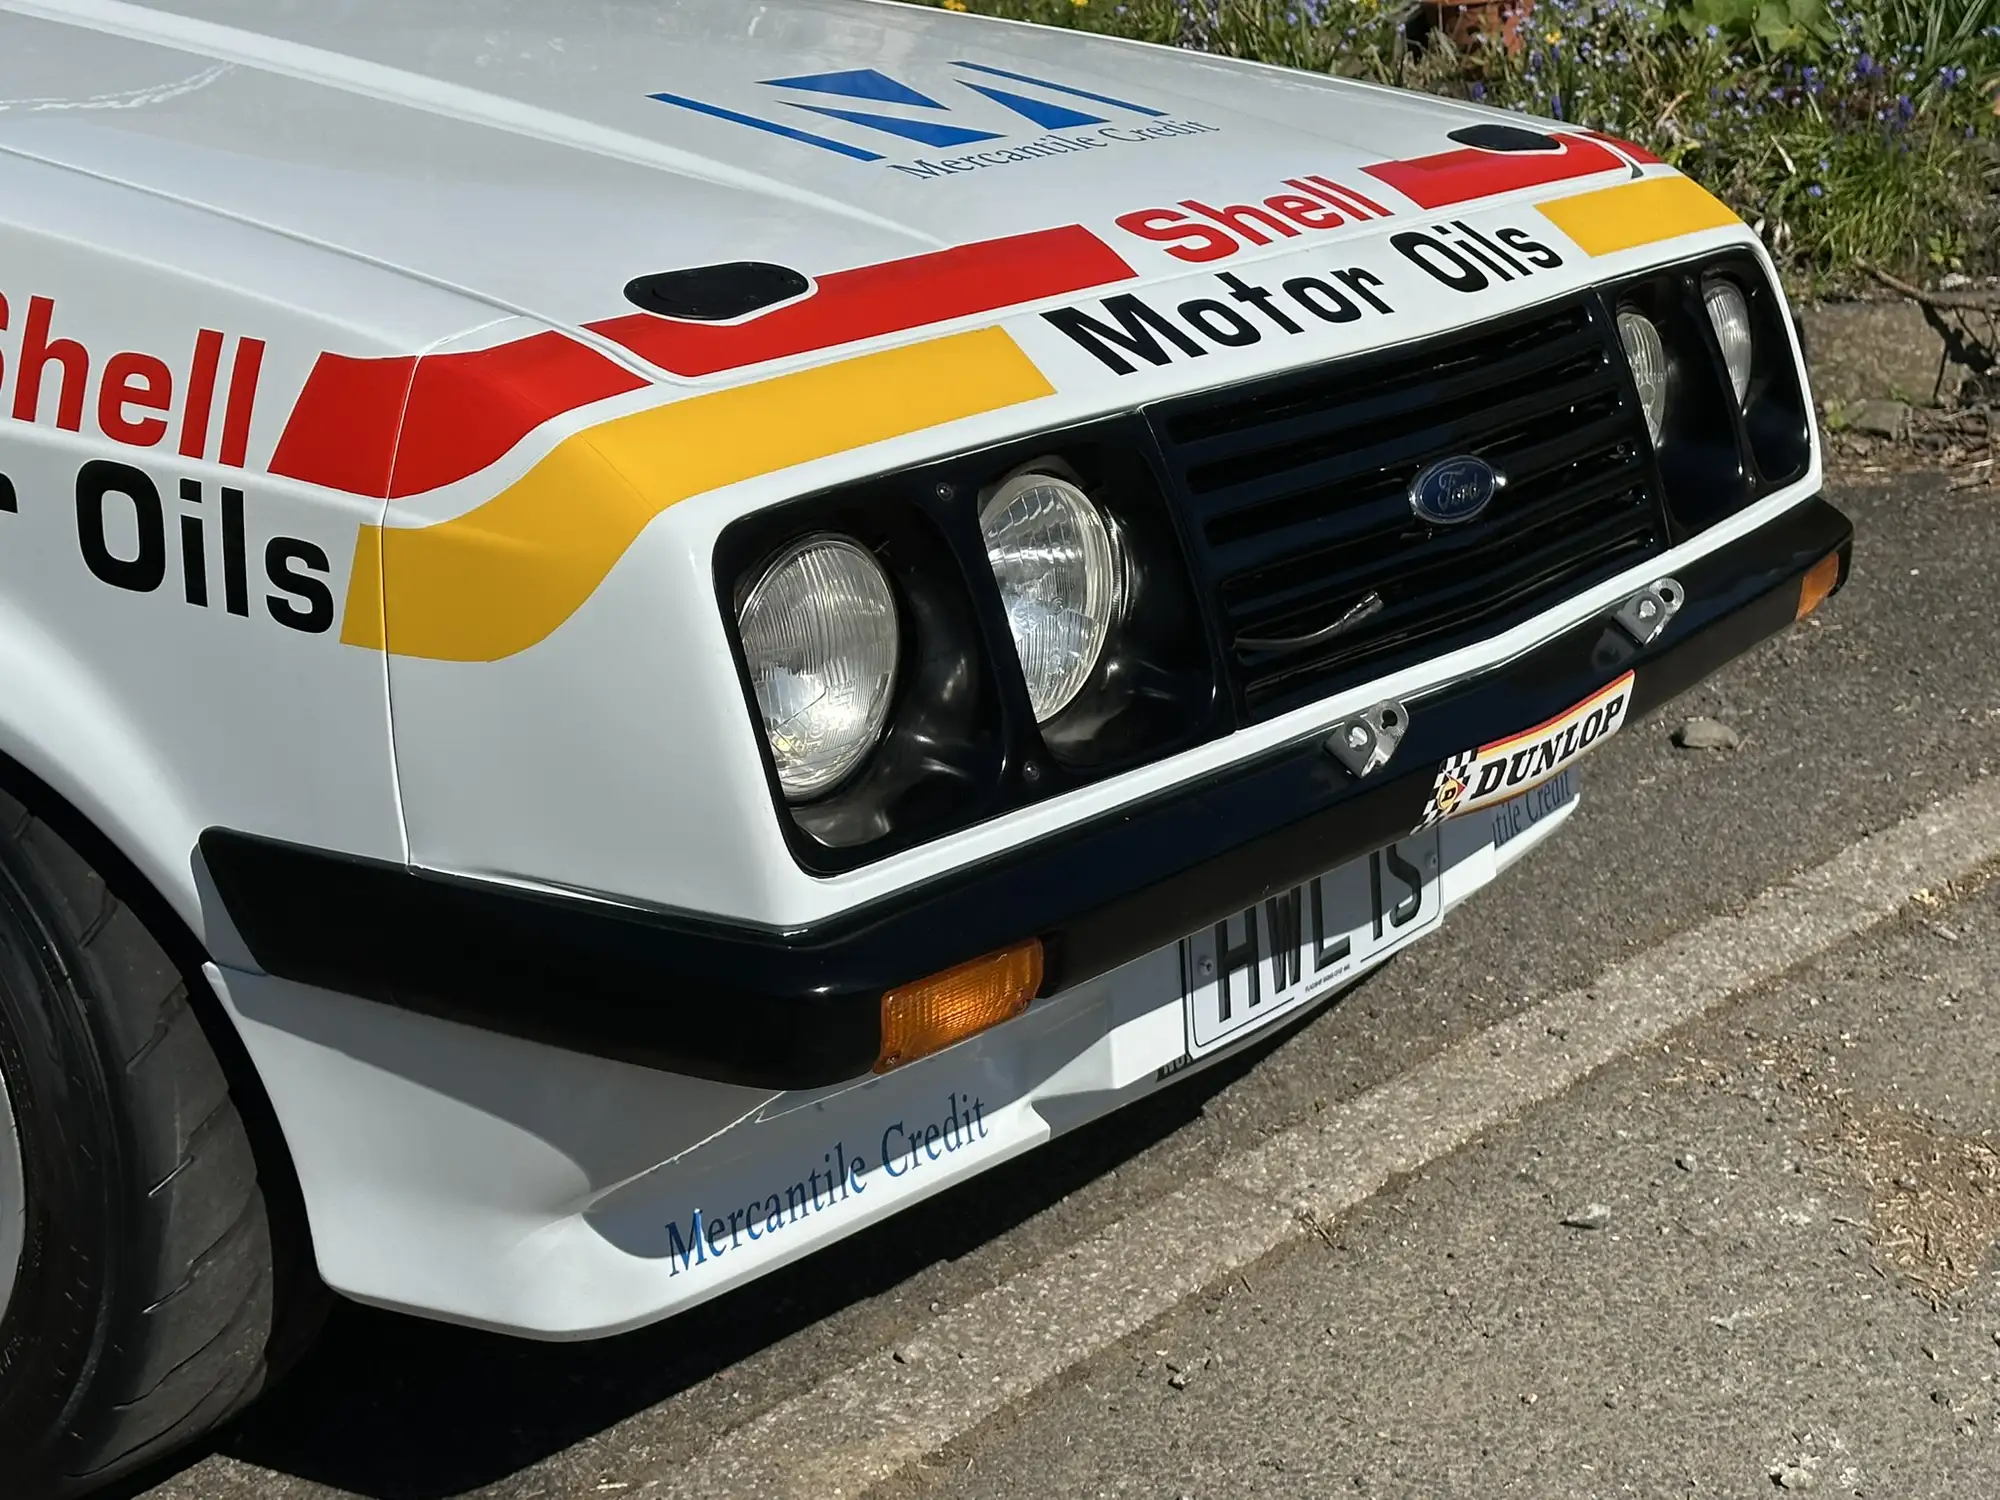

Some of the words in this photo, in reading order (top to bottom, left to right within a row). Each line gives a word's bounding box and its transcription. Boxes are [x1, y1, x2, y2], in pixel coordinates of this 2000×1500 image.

[886, 133, 1107, 179] Mercantile
[1098, 119, 1220, 143] Credit
[1114, 175, 1396, 263] Shell
[1038, 267, 1395, 376] Motor
[1390, 220, 1563, 293] Oils
[0, 290, 266, 469] hell
[75, 458, 334, 635] Oils
[1437, 466, 1482, 511] Ford
[1469, 693, 1625, 801] DUNLOP
[1213, 876, 1351, 1023] HWL
[664, 1141, 868, 1278] Mercantile
[880, 1092, 989, 1178] Credit
